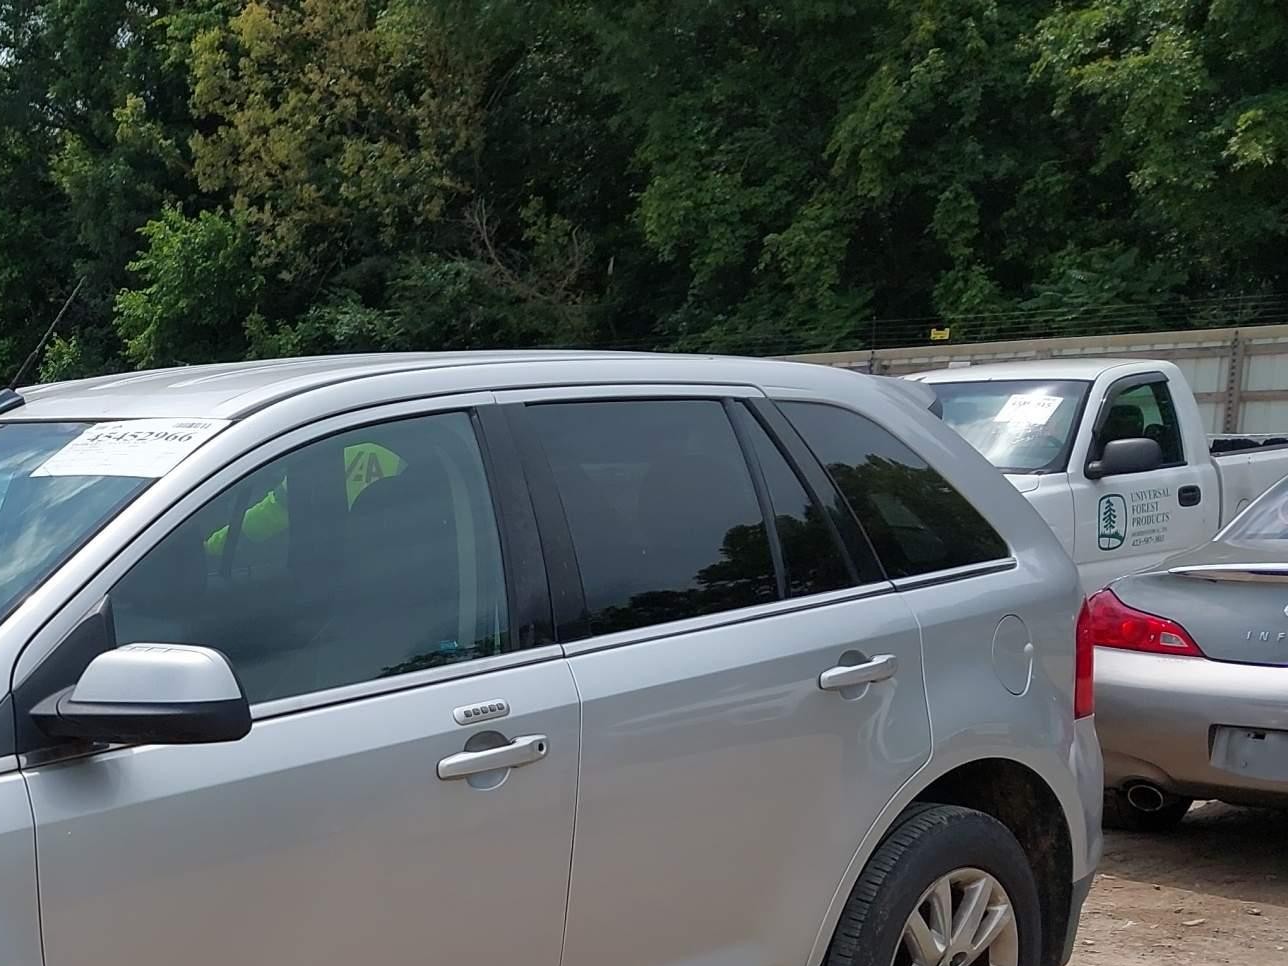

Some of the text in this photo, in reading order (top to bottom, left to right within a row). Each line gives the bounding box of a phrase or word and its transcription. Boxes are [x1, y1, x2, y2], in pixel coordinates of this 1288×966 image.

[87, 430, 193, 443] 45452966
[1131, 488, 1170, 502] UNIVERSAL
[1132, 501, 1159, 515] FOREST
[1132, 512, 1170, 528] PRODUCTS
